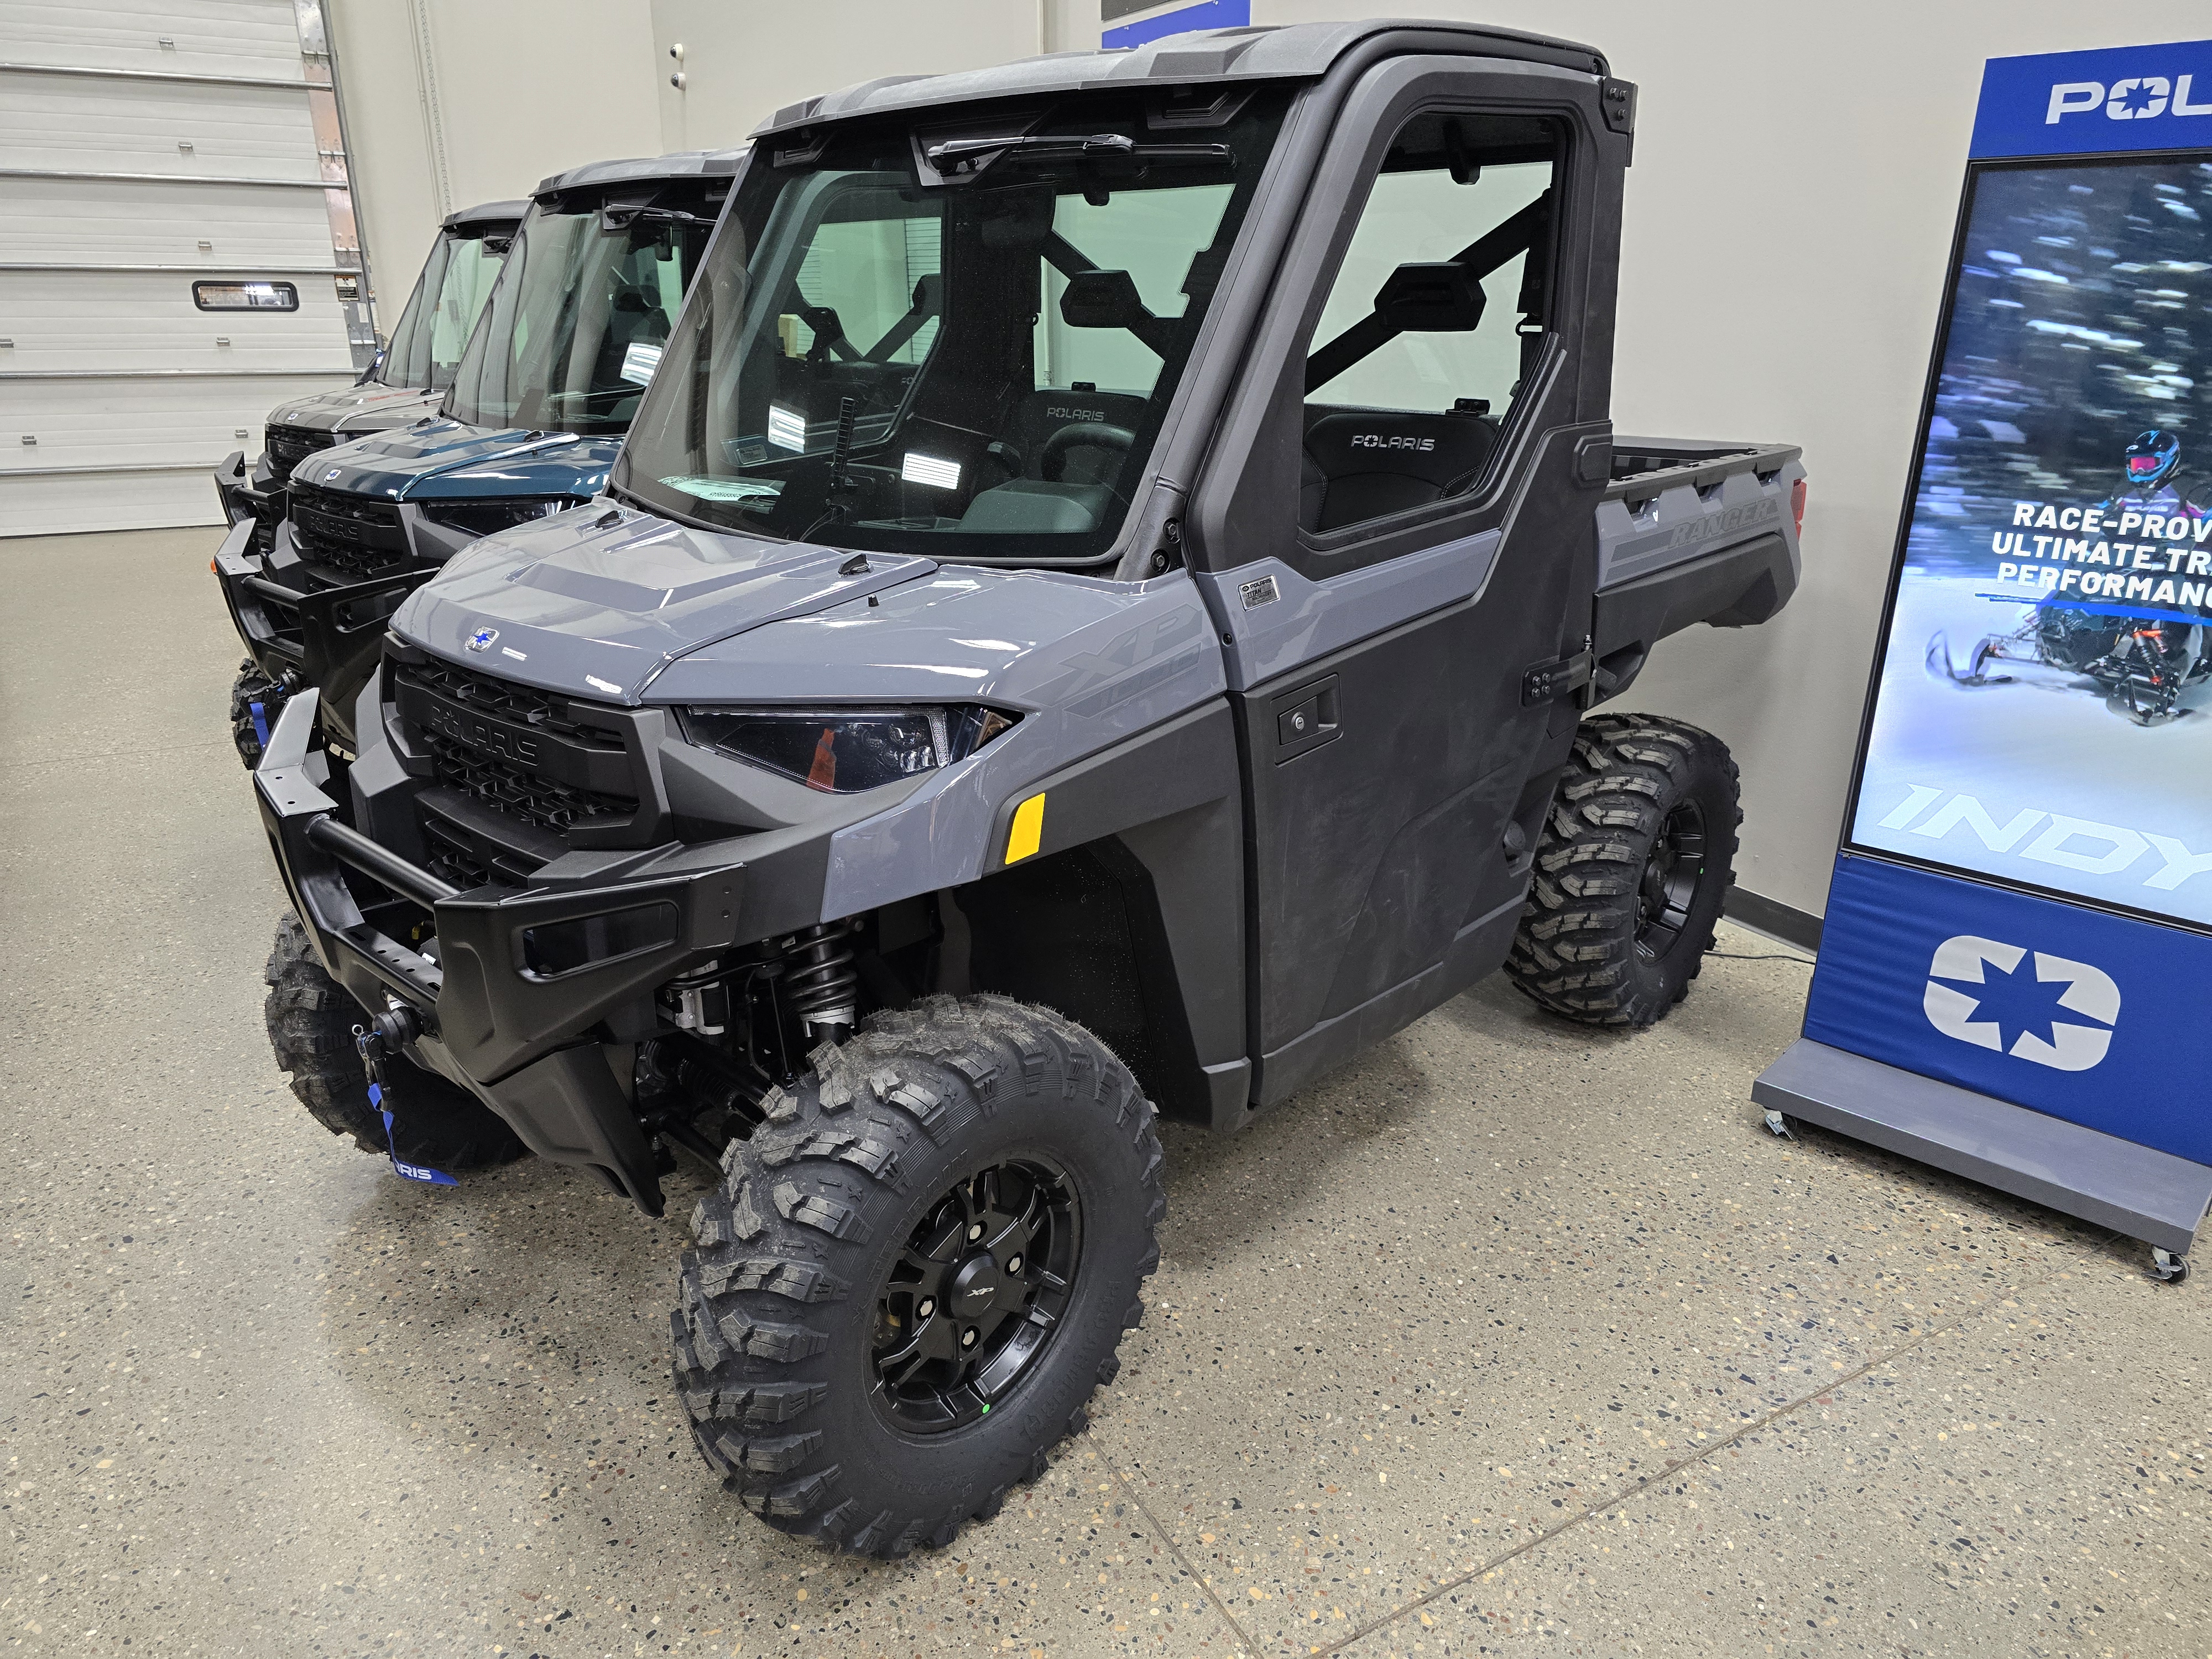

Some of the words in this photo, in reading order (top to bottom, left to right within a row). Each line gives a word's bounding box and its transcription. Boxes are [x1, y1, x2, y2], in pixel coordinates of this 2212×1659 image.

[1047, 407, 1105, 422] POLARIS
[1350, 435, 1435, 451] POLARIS
[1667, 498, 1772, 549] RANGER
[2013, 502, 2212, 542] RACE-PROV
[1991, 531, 2157, 570] ULTIMATE
[2166, 548, 2212, 576] TR
[1246, 588, 1262, 598] TITAN
[1250, 578, 1272, 589] POLARIS
[1252, 591, 1272, 601] MACHINERY
[1056, 603, 1200, 701] XP
[430, 705, 540, 766] POLARIS
[1877, 782, 2212, 891] INDY
[967, 1287, 994, 1297] XP
